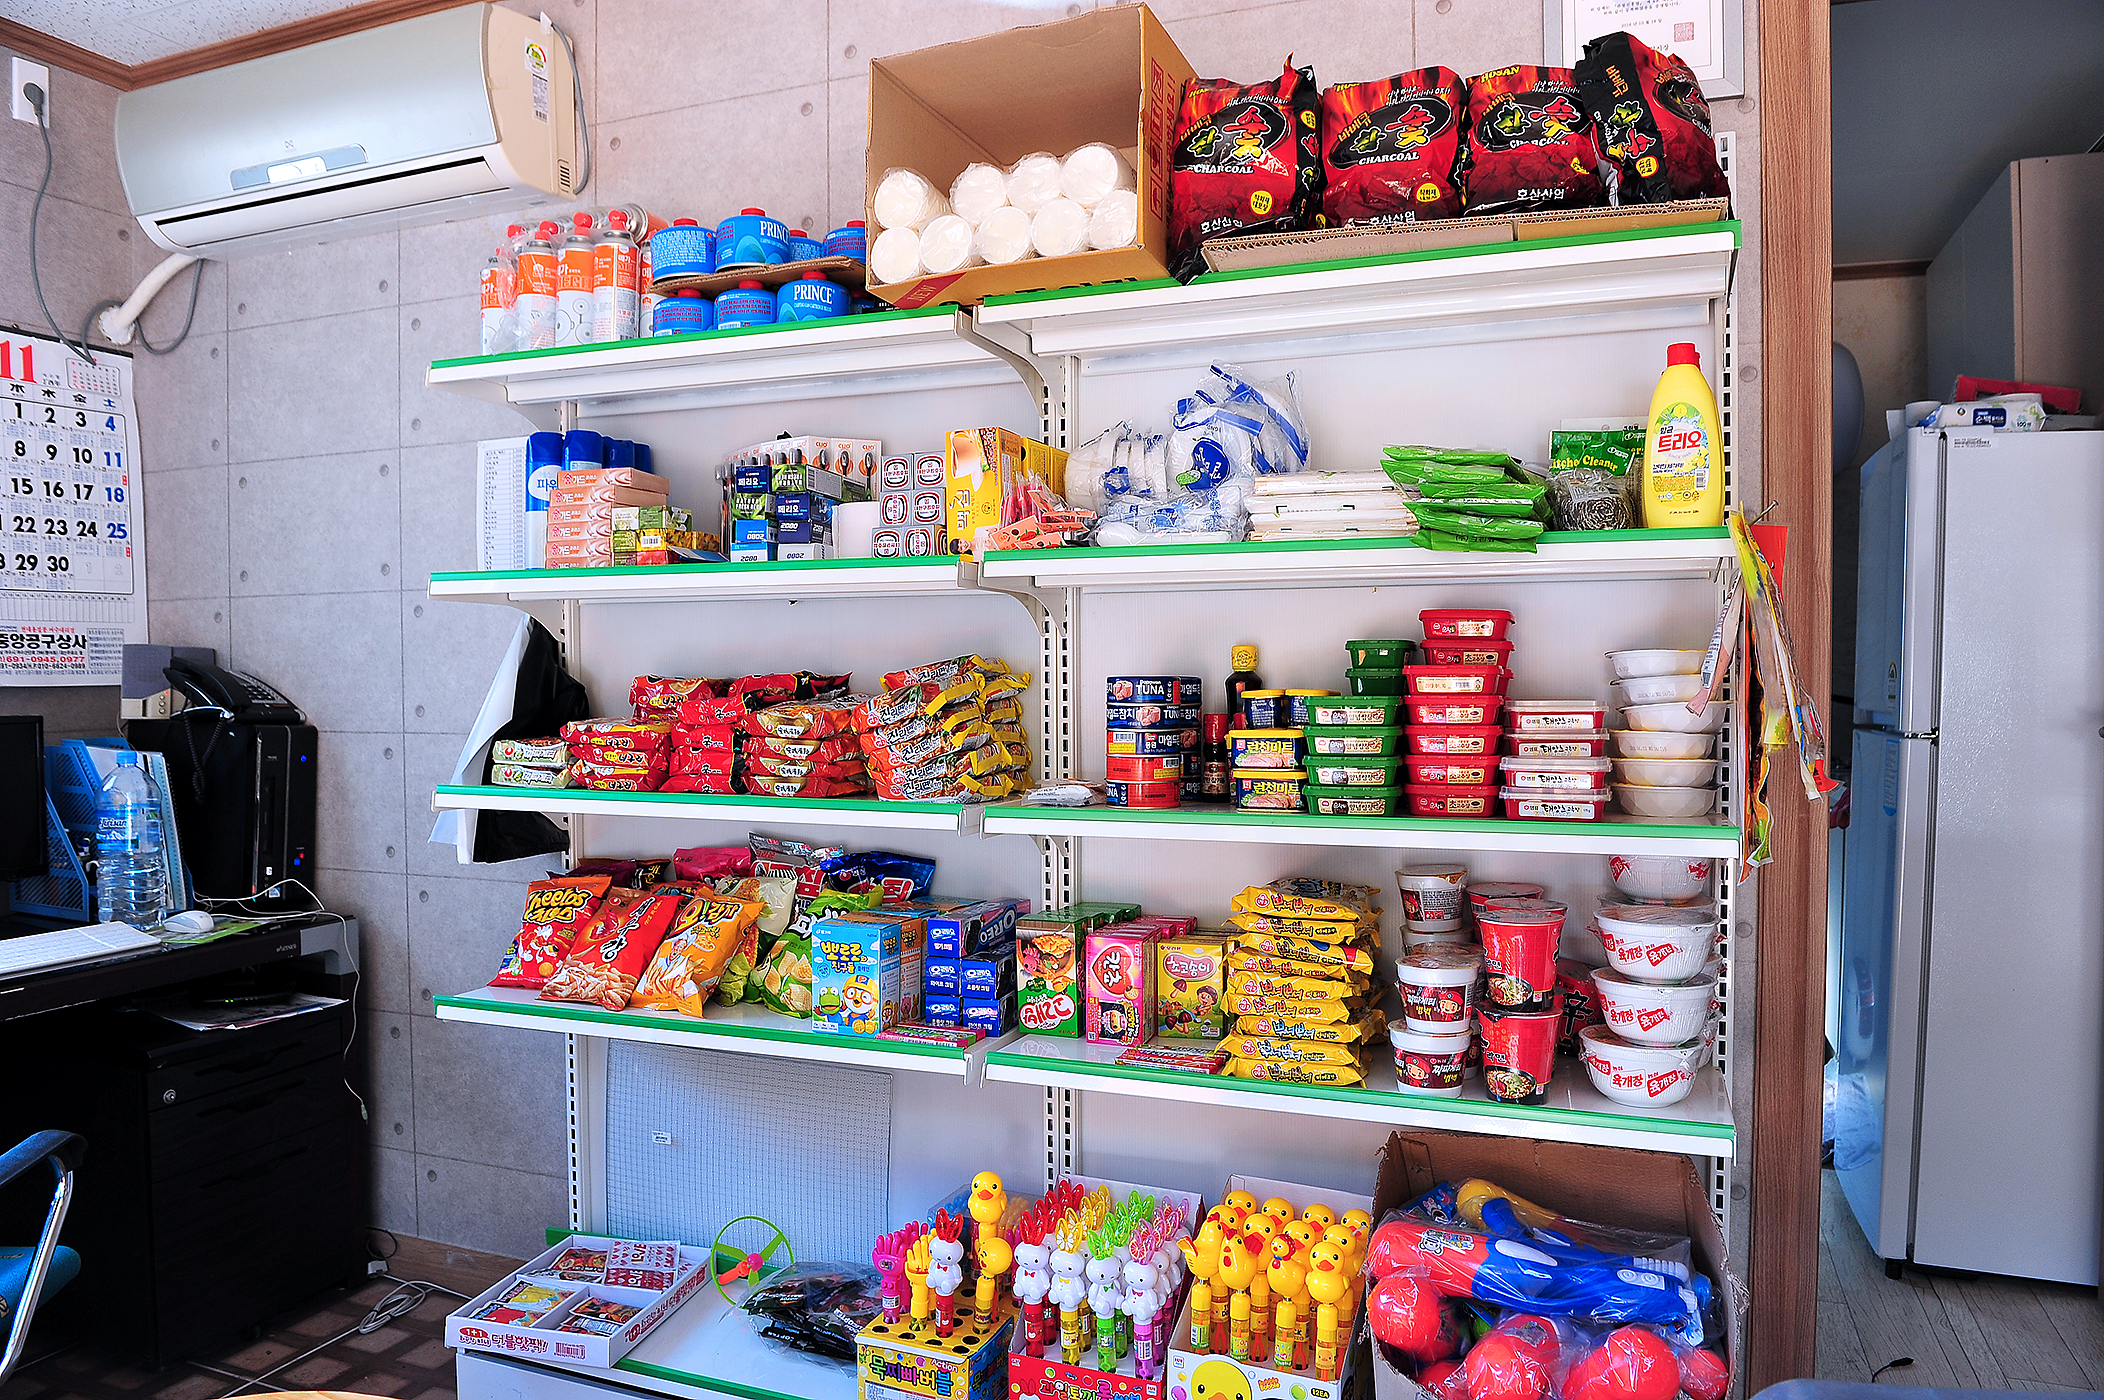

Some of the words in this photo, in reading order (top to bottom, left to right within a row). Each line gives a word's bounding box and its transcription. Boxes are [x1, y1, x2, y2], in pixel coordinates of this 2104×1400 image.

[1359, 151, 1420, 165] CHARCOAL
[794, 285, 833, 305] PRINCE
[917, 283, 937, 301] NEW
[0, 340, 38, 384] 11
[73, 394, 87, 404] 金
[103, 399, 116, 408] 土
[14, 402, 22, 419] 1
[45, 407, 56, 424] 2
[75, 412, 87, 427] 3
[106, 416, 116, 431] 4
[1658, 430, 1702, 452] 트리오
[14, 440, 26, 456] 8
[46, 445, 57, 460] 9
[72, 447, 93, 464] 10
[104, 452, 121, 467] 11
[1582, 455, 1618, 472] Cleaner
[11, 478, 33, 495] 15
[43, 481, 64, 497] 16
[74, 483, 94, 500] 17
[105, 487, 124, 502] 18
[12, 516, 37, 533] 22
[44, 518, 68, 535] 23
[76, 520, 98, 538] 24
[106, 523, 127, 539] 25
[15, 553, 38, 571] 29
[47, 556, 69, 572] 30
[1136, 685, 1164, 695] TUNA
[1542, 716, 1566, 726] 태양초
[1247, 741, 1293, 754] 런천미트
[1539, 744, 1564, 754] 태양초
[1538, 774, 1562, 784] 태양초
[1253, 782, 1299, 794] 런천미트
[1541, 803, 1566, 814] 태양초
[677, 898, 742, 926] 오!감자
[979, 905, 1017, 944] OREO
[930, 928, 956, 939] 오레오
[1618, 944, 1644, 963] 육개장
[832, 962, 856, 975] 친구들
[930, 965, 956, 976] 오레오
[964, 968, 990, 978] 오레오
[1103, 951, 1123, 987] 칸쵸
[1166, 955, 1211, 977] 초코송이
[929, 1003, 956, 1013] 오레오
[1023, 996, 1072, 1025] 고래밥
[1563, 989, 1594, 1036] 辛
[1610, 1006, 1634, 1023] 육개장
[1612, 1070, 1643, 1089] 육개장
[1650, 1072, 1677, 1094] 육개장
[465, 1328, 483, 1337] 1+1
[931, 1358, 958, 1374] Action
[869, 1358, 954, 1397] 묵찌빠버블
[1312, 1388, 1329, 1399] 12EA
